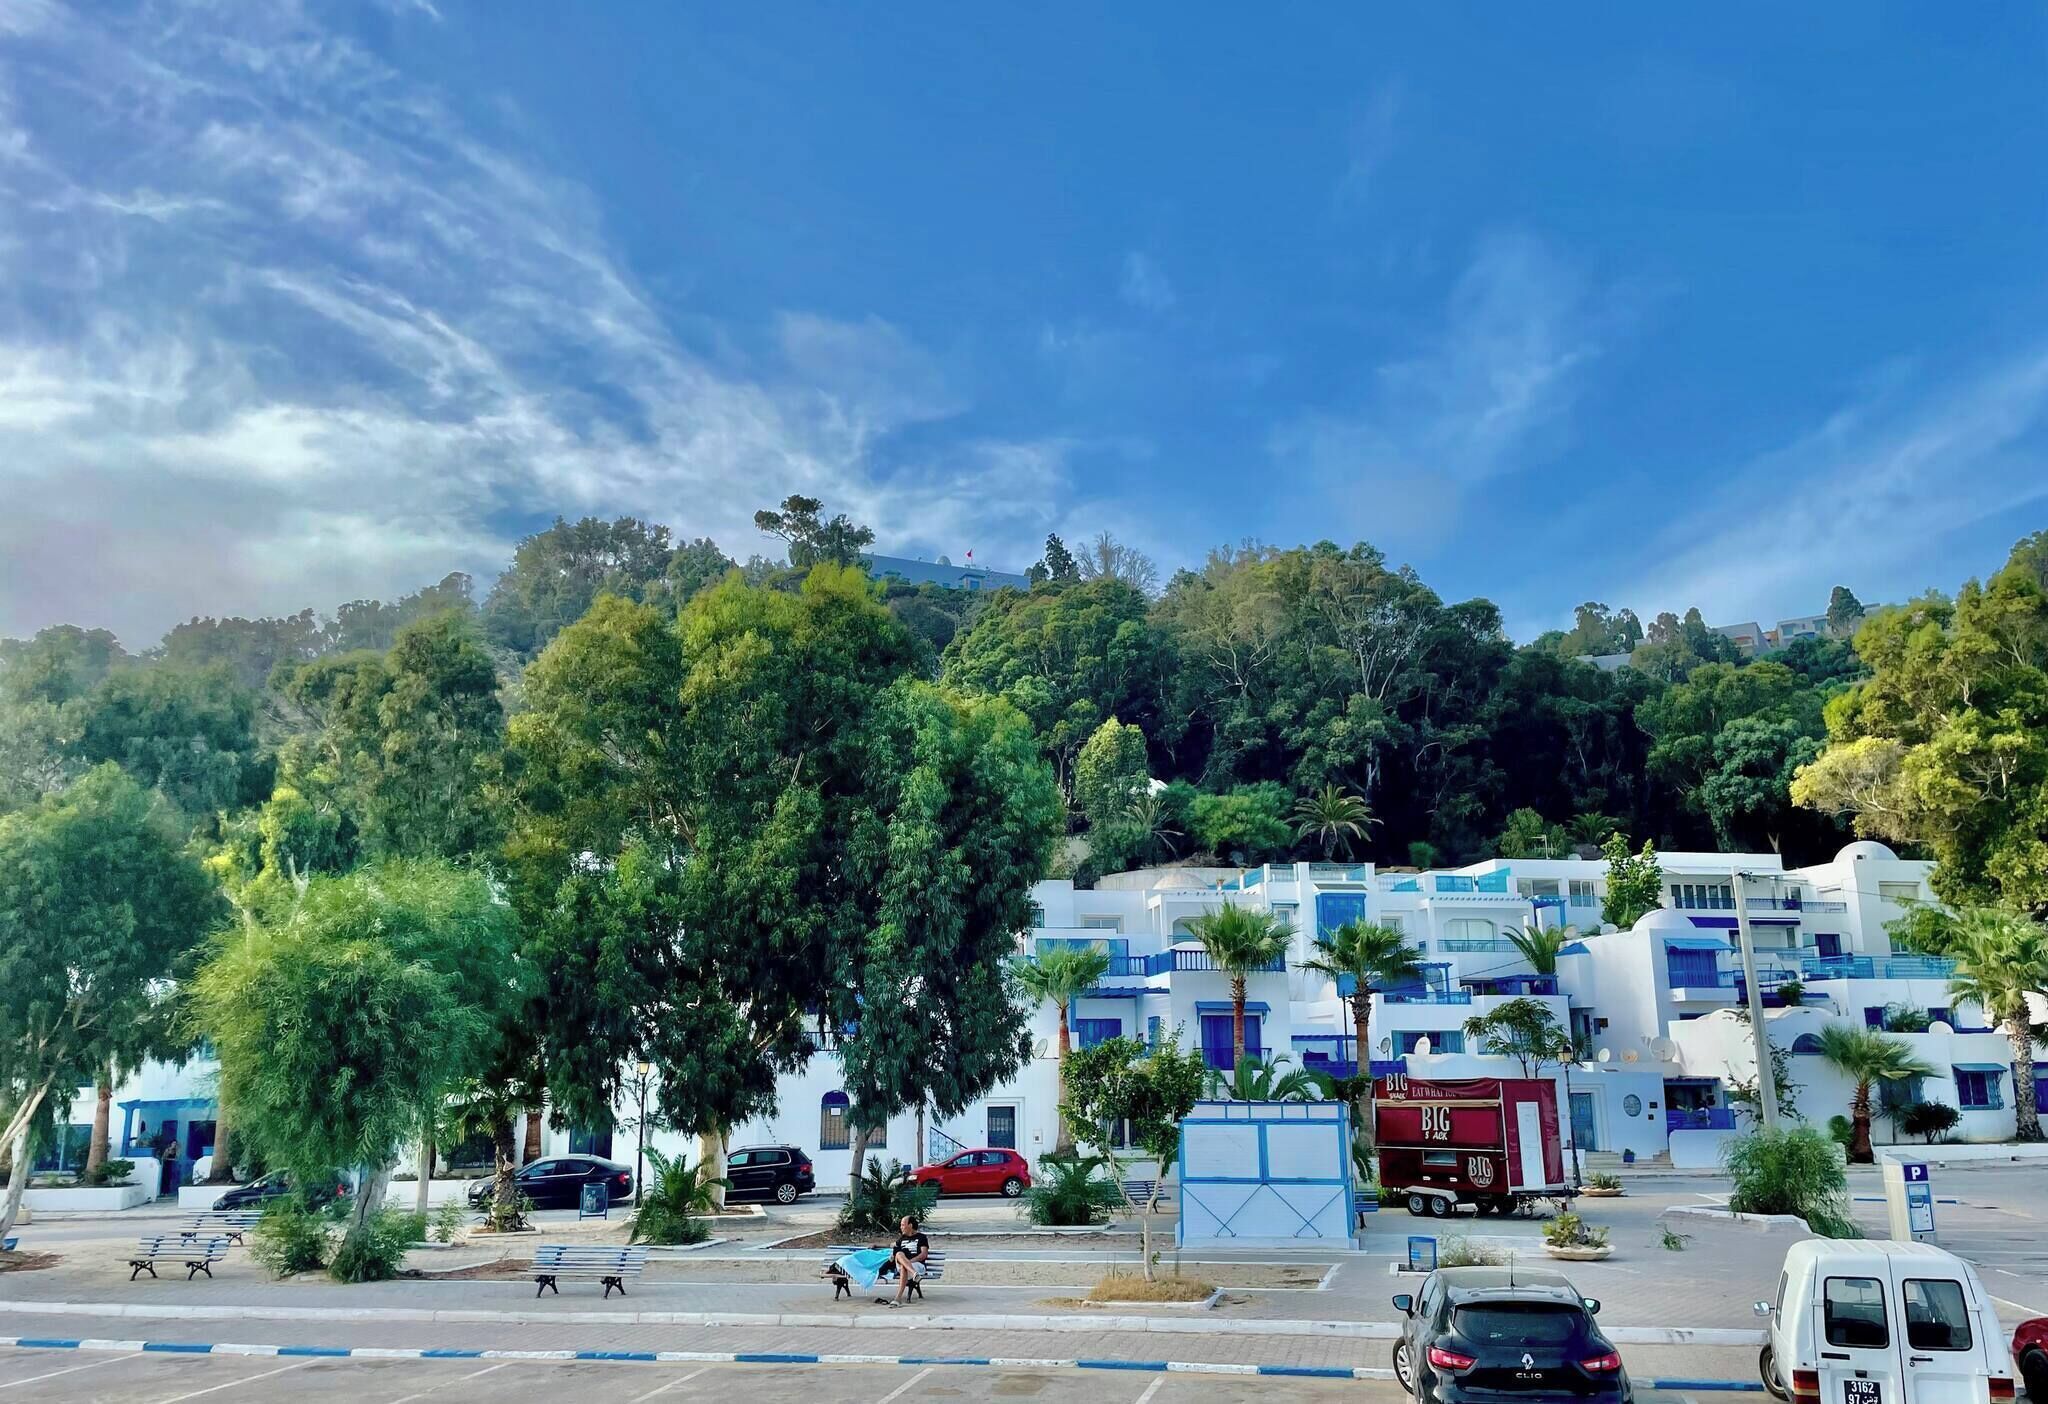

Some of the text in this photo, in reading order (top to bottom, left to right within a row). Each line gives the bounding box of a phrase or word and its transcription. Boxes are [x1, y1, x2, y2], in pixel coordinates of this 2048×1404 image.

[1386, 1073, 1408, 1091] BIG
[1421, 1106, 1450, 1131] BIG
[1424, 1131, 1448, 1141] SACK
[1468, 1156, 1491, 1177] BIG
[1911, 1166, 1921, 1180] P
[1851, 1381, 1875, 1393] 3162
[1848, 1394, 1860, 1404] 97
